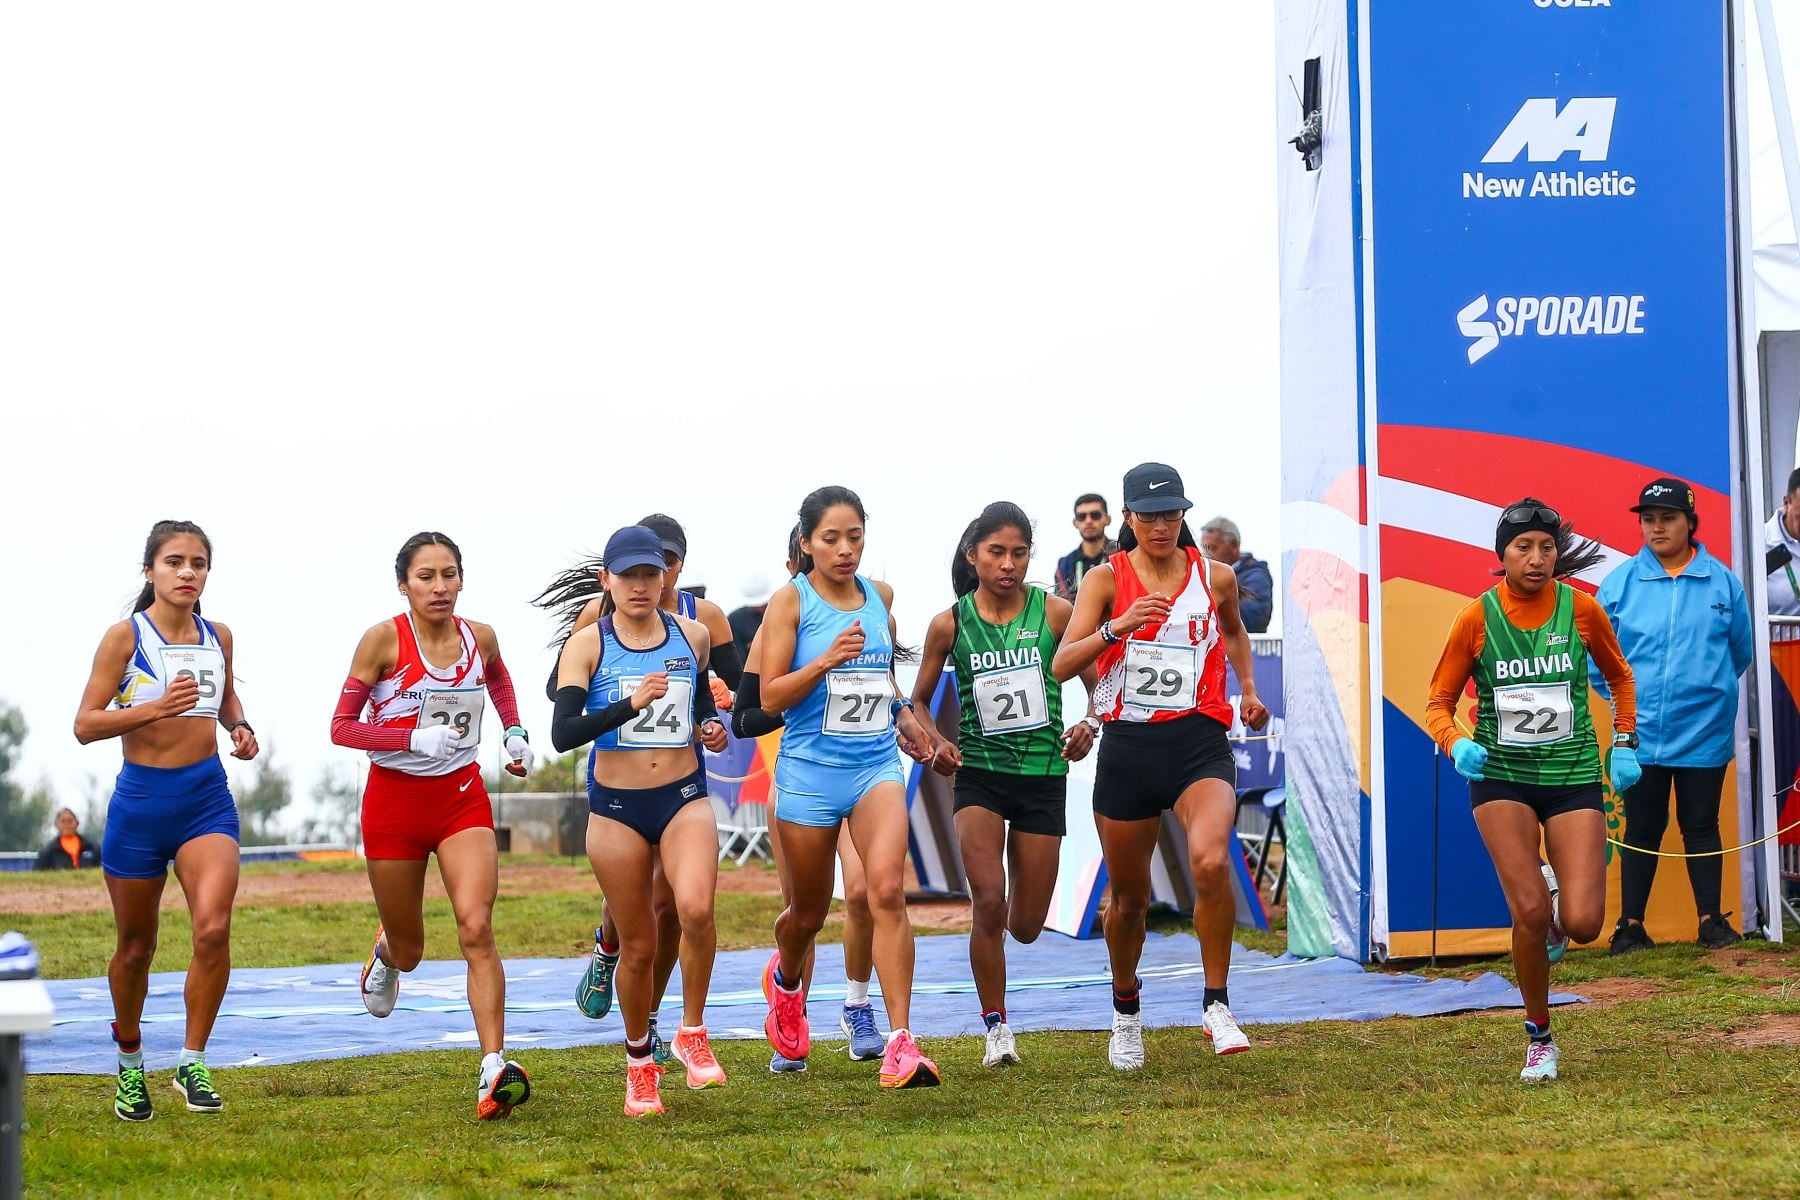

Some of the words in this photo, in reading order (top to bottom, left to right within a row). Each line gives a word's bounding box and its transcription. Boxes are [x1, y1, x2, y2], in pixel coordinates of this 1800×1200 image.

[1462, 172, 1525, 198] New
[1529, 170, 1636, 197] Athletic
[1495, 295, 1645, 337] SPORADE
[969, 646, 1042, 671] BOLIVIA
[1131, 646, 1163, 657] Ayacucho
[832, 675, 865, 684] Ayacucho
[1495, 652, 1574, 680] BOLIVIA
[1136, 666, 1183, 697] 29
[430, 694, 459, 703] Ayacucho
[839, 693, 884, 723] 27
[992, 688, 1031, 722] 21
[1502, 690, 1535, 702] Ayacucho
[632, 703, 681, 733] 24
[1513, 706, 1559, 734] 22
